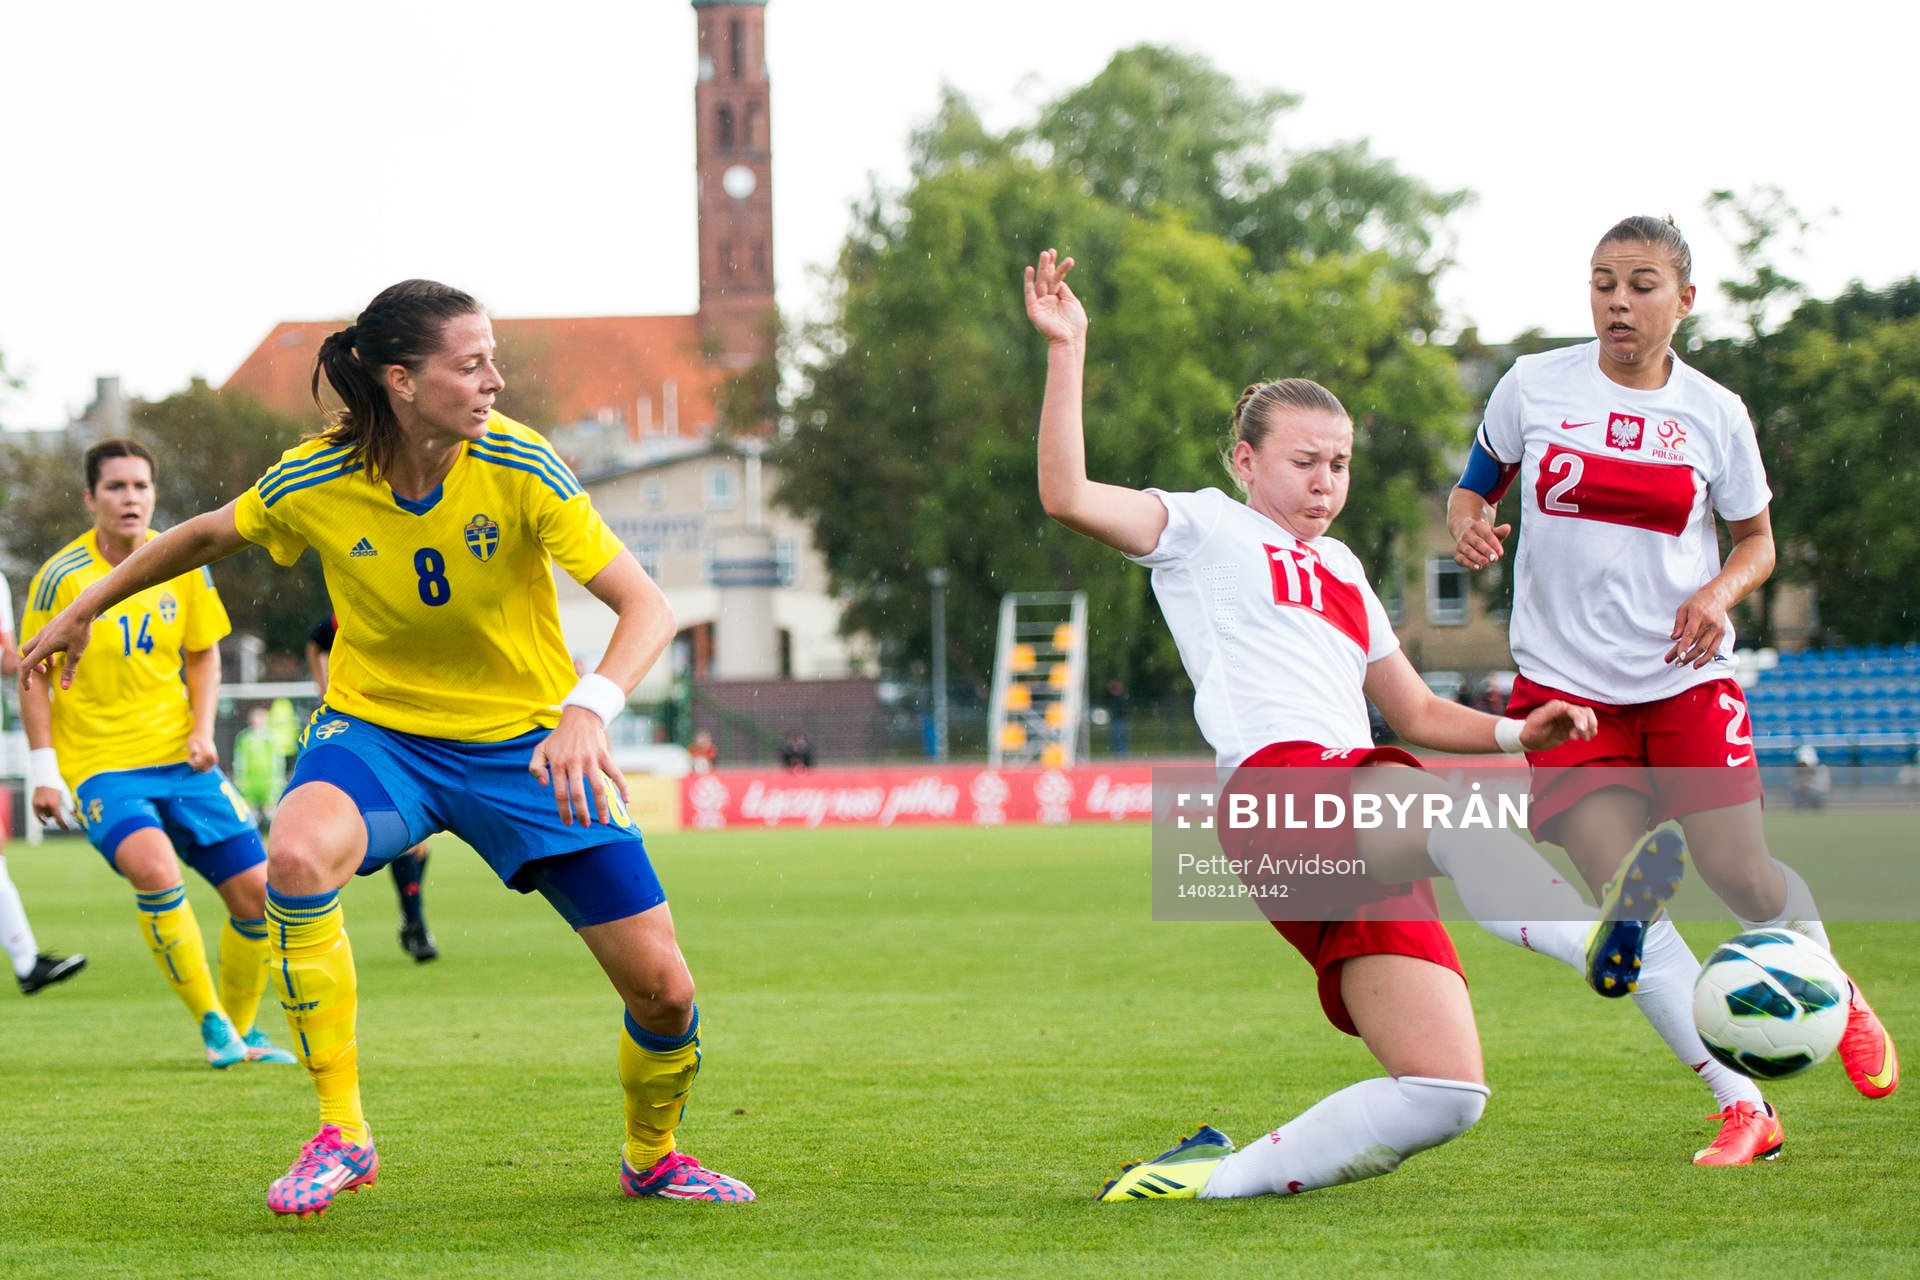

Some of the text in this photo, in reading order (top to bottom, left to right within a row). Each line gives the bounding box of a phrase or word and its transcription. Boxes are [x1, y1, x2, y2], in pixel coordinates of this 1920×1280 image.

[1652, 449, 1684, 461] POLSKA
[1545, 453, 1584, 513] 2
[349, 549, 378, 557] adidas
[414, 547, 451, 607] 8
[1271, 550, 1323, 612] 11
[119, 613, 154, 656] 14
[1719, 693, 1752, 745] 2
